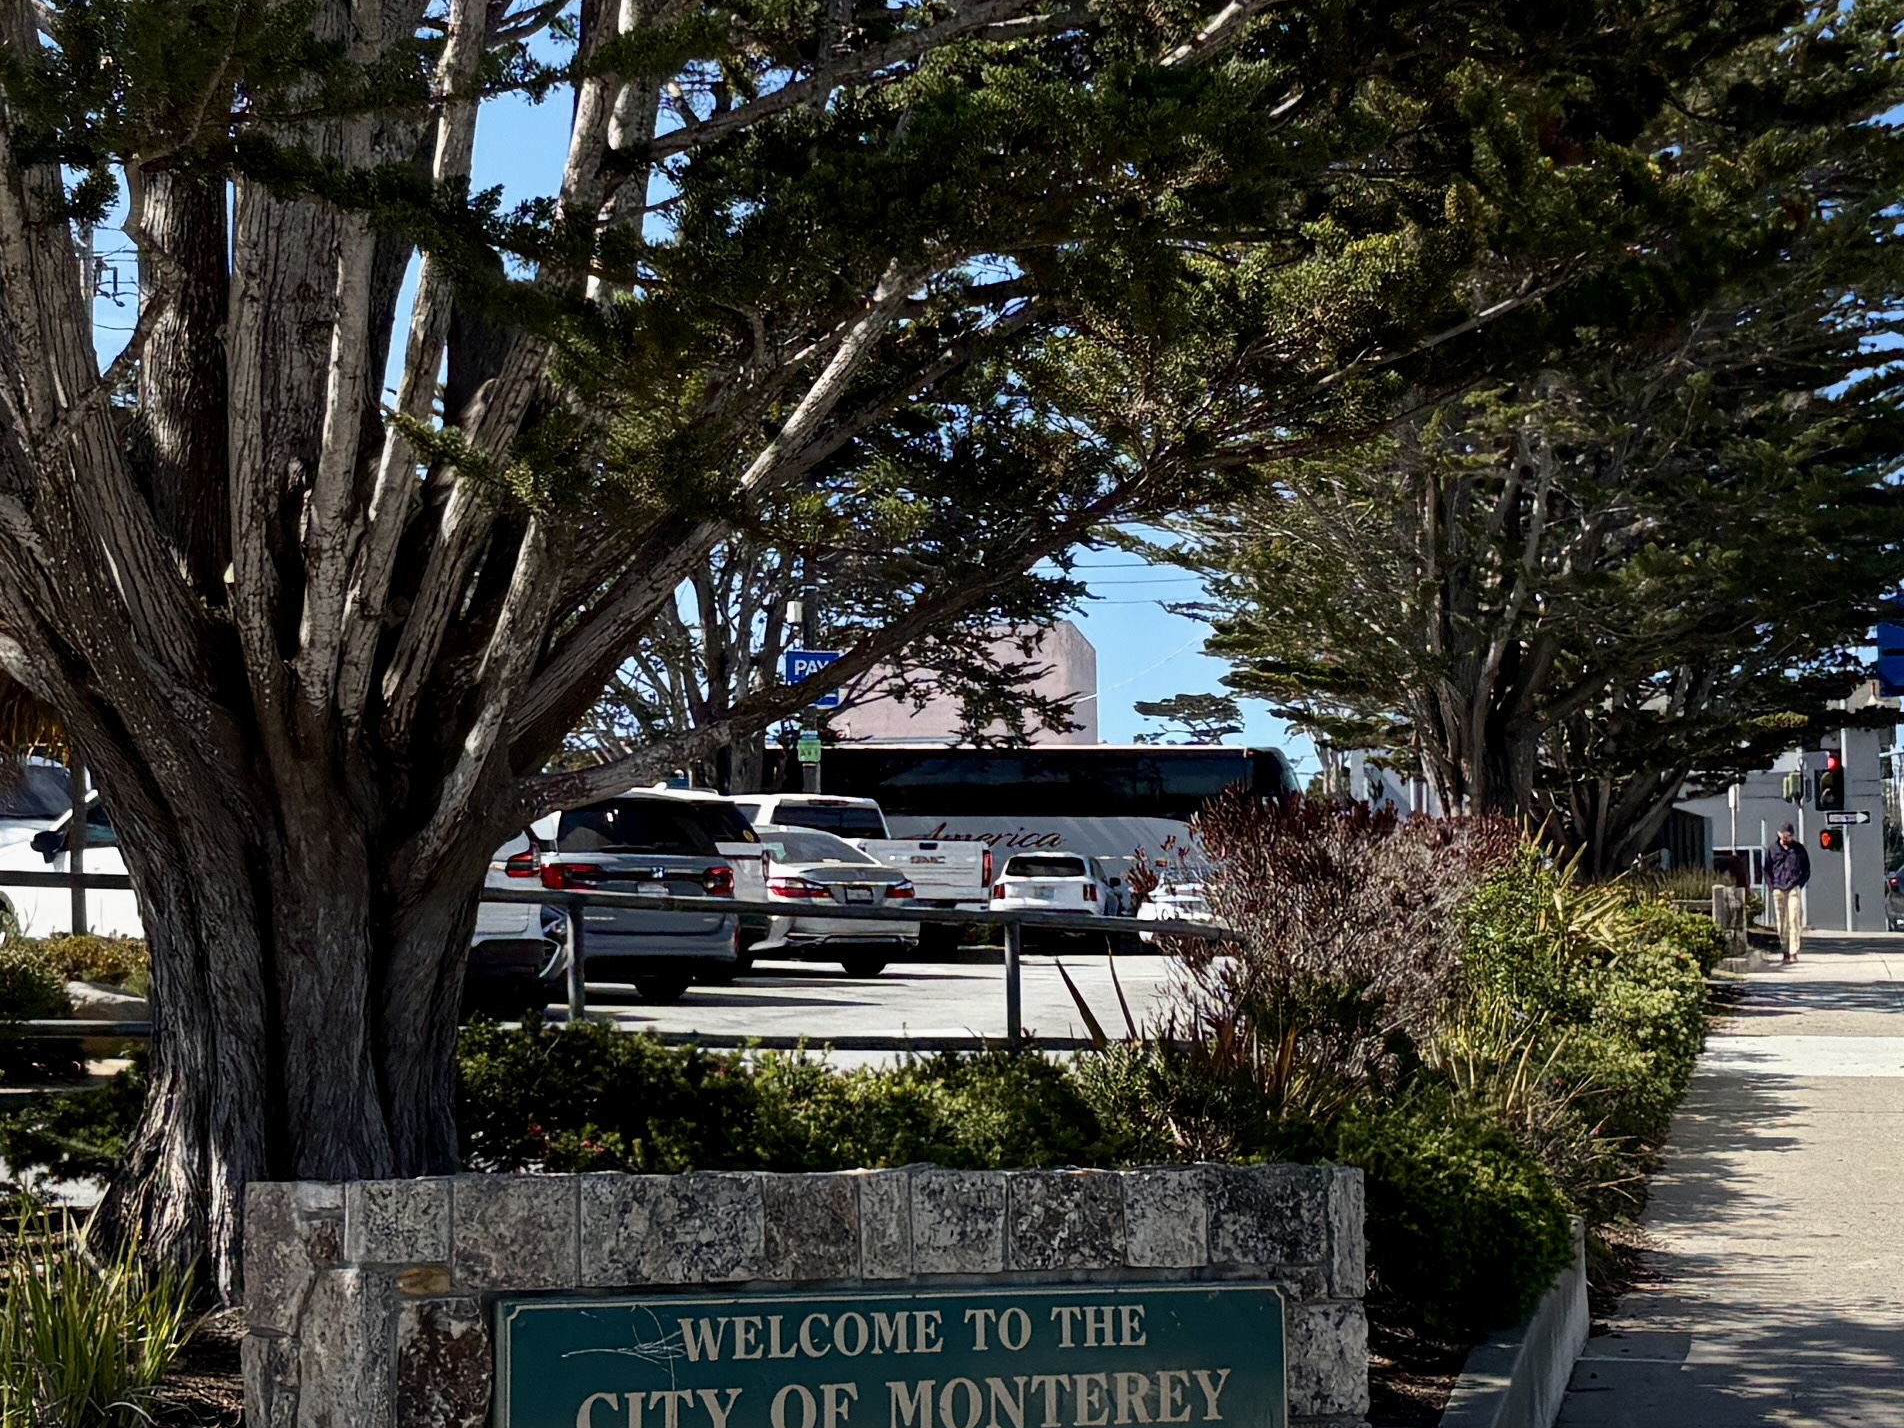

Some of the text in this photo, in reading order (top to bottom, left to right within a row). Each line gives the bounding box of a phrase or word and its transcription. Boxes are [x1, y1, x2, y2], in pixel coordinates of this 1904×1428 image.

[677, 1304, 1147, 1362] WELCOME TO THE
